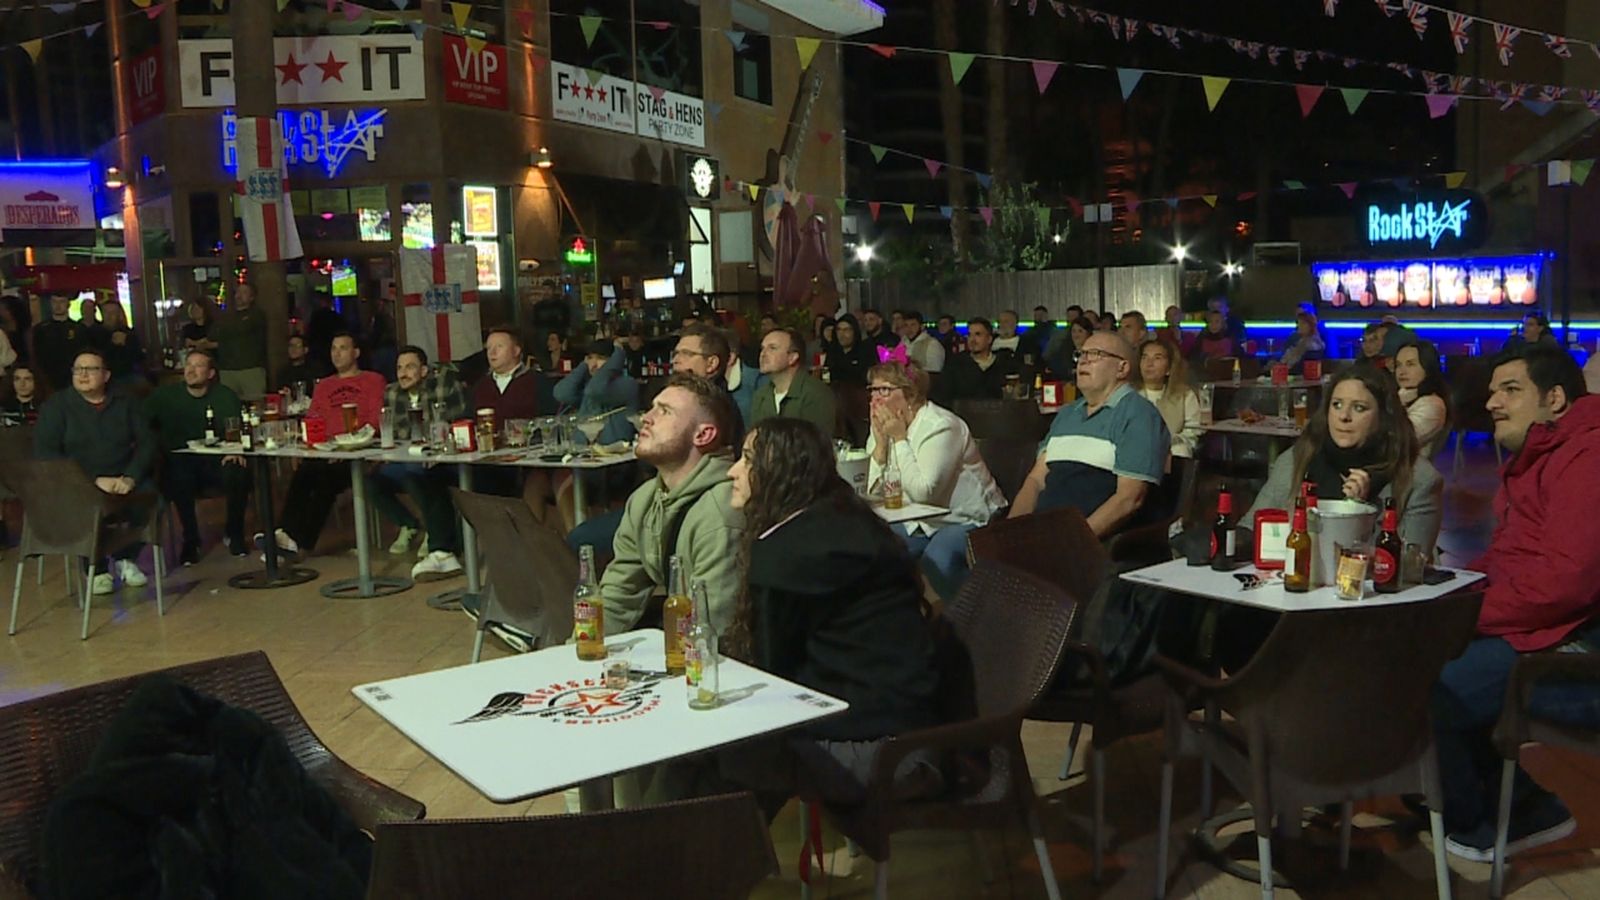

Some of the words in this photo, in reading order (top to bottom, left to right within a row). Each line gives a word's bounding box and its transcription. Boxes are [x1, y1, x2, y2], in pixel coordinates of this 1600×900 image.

[133, 56, 157, 97] VIP
[452, 43, 499, 84] VIP
[638, 92, 667, 119] STAG
[668, 106, 674, 120] &
[675, 101, 703, 126] HENS
[648, 118, 675, 134] PARTY
[674, 123, 695, 139] ZONE
[5, 204, 80, 225] DESPERADOS
